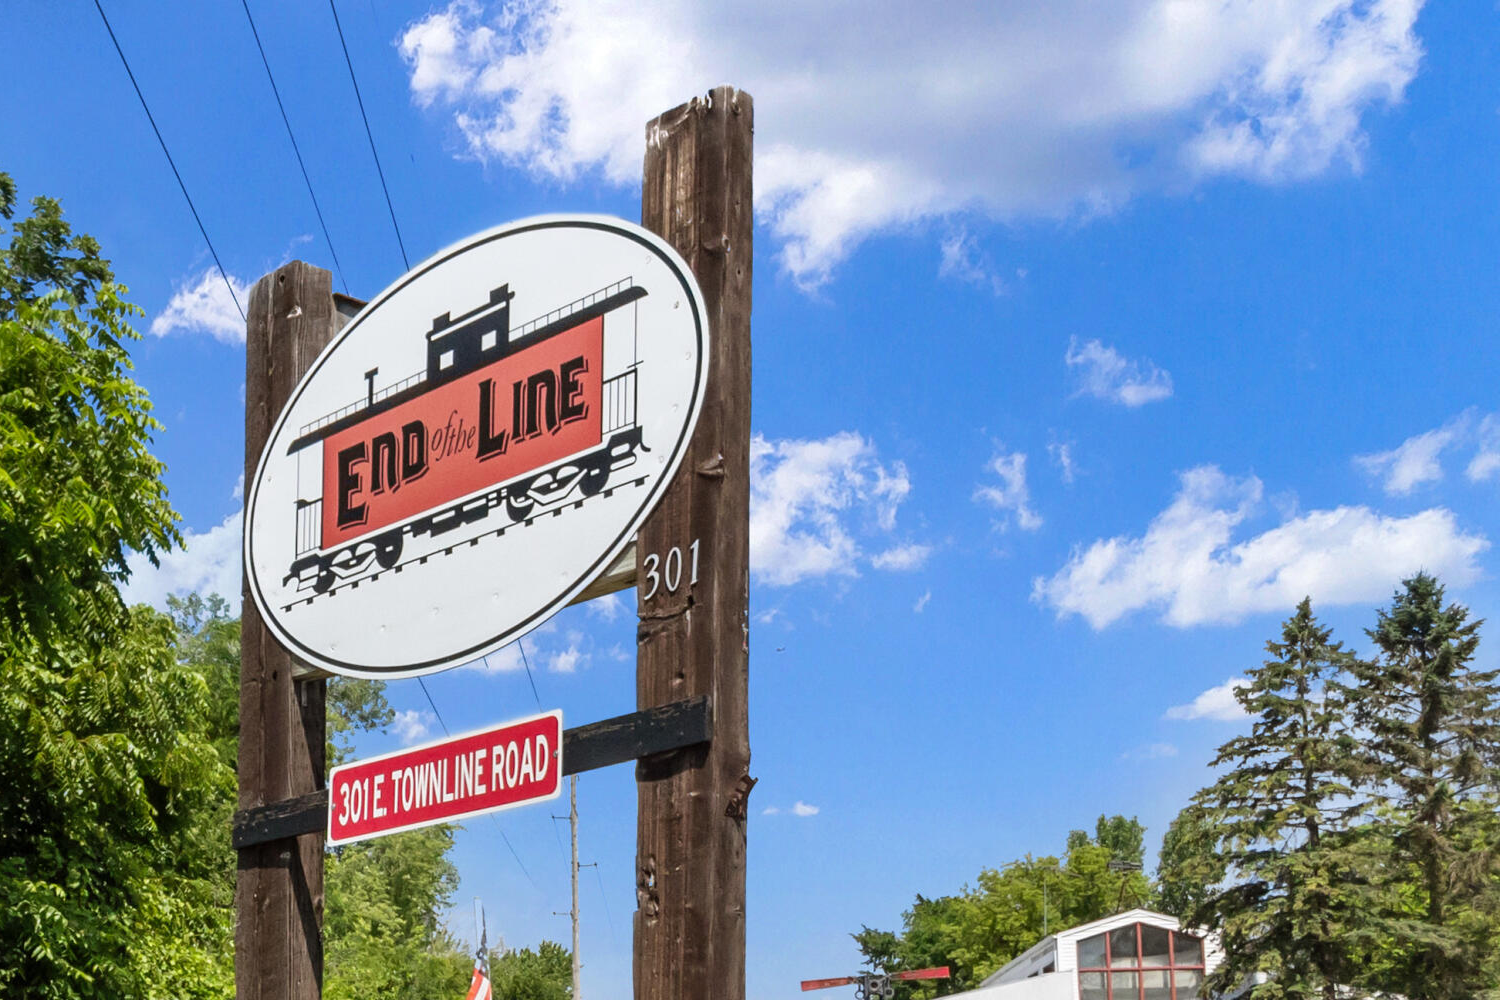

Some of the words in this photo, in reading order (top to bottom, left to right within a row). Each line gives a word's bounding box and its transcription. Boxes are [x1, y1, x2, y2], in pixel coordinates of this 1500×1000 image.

[431, 409, 458, 461] of
[449, 418, 476, 457] the
[643, 538, 700, 601] 301
[339, 778, 369, 826] 301
[373, 774, 388, 819] E.
[392, 749, 487, 814] TOWNLINE
[492, 734, 549, 792] ROAD
